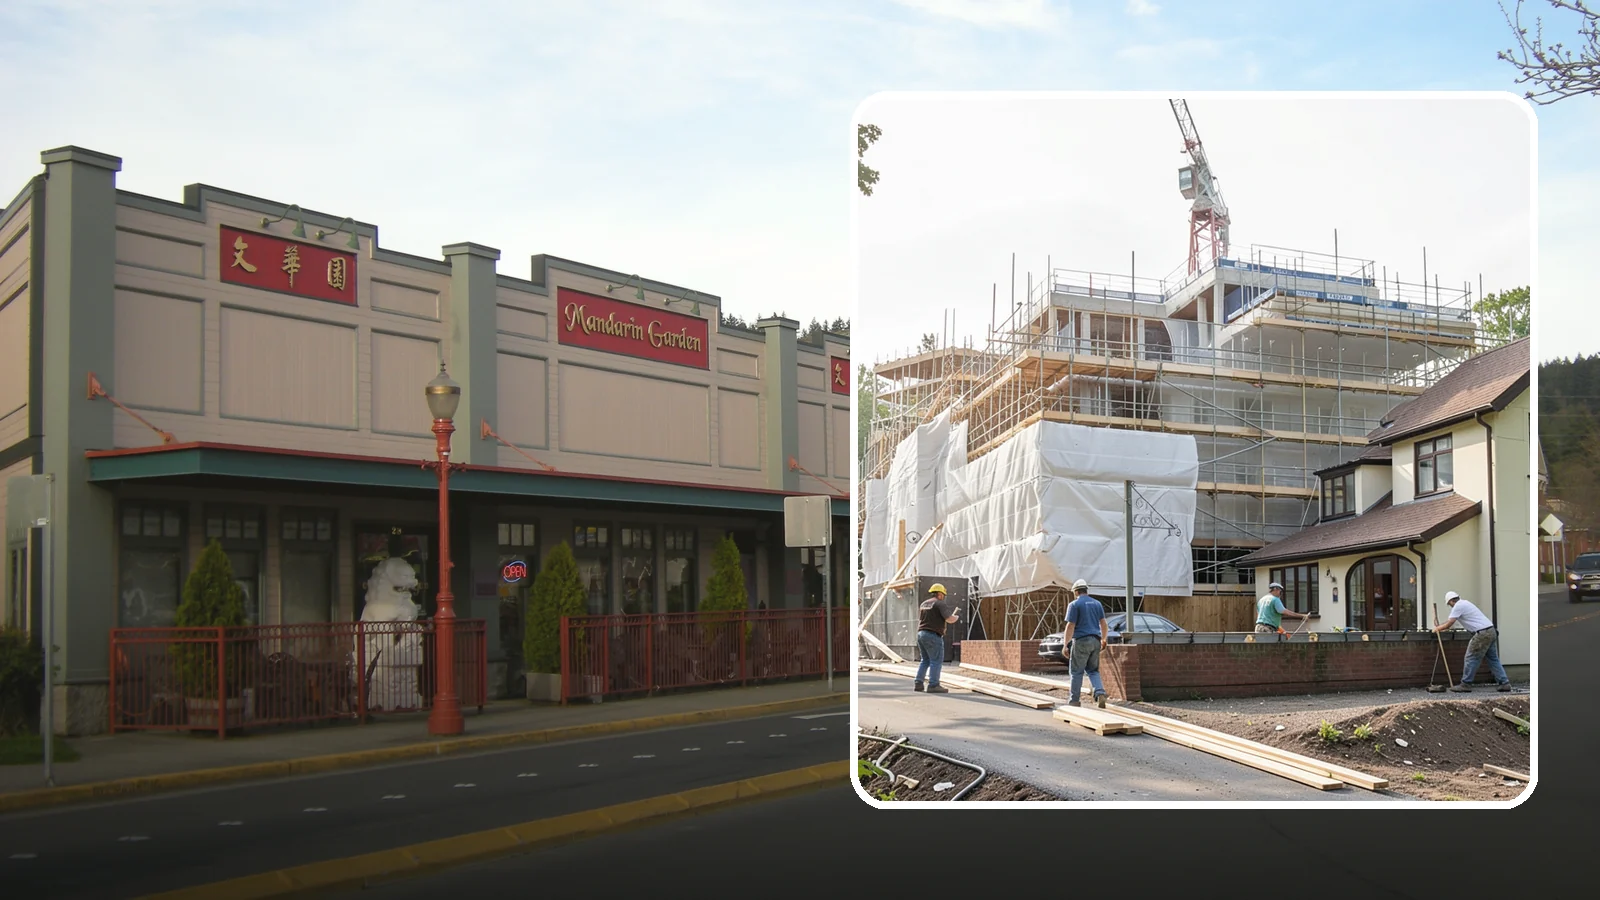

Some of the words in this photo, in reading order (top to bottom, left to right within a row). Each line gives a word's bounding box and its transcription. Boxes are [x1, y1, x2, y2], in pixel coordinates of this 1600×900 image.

[564, 302, 643, 341] Mandarin
[648, 320, 701, 353] Garden
[835, 363, 846, 386] 文
[503, 565, 526, 578] OPEN
